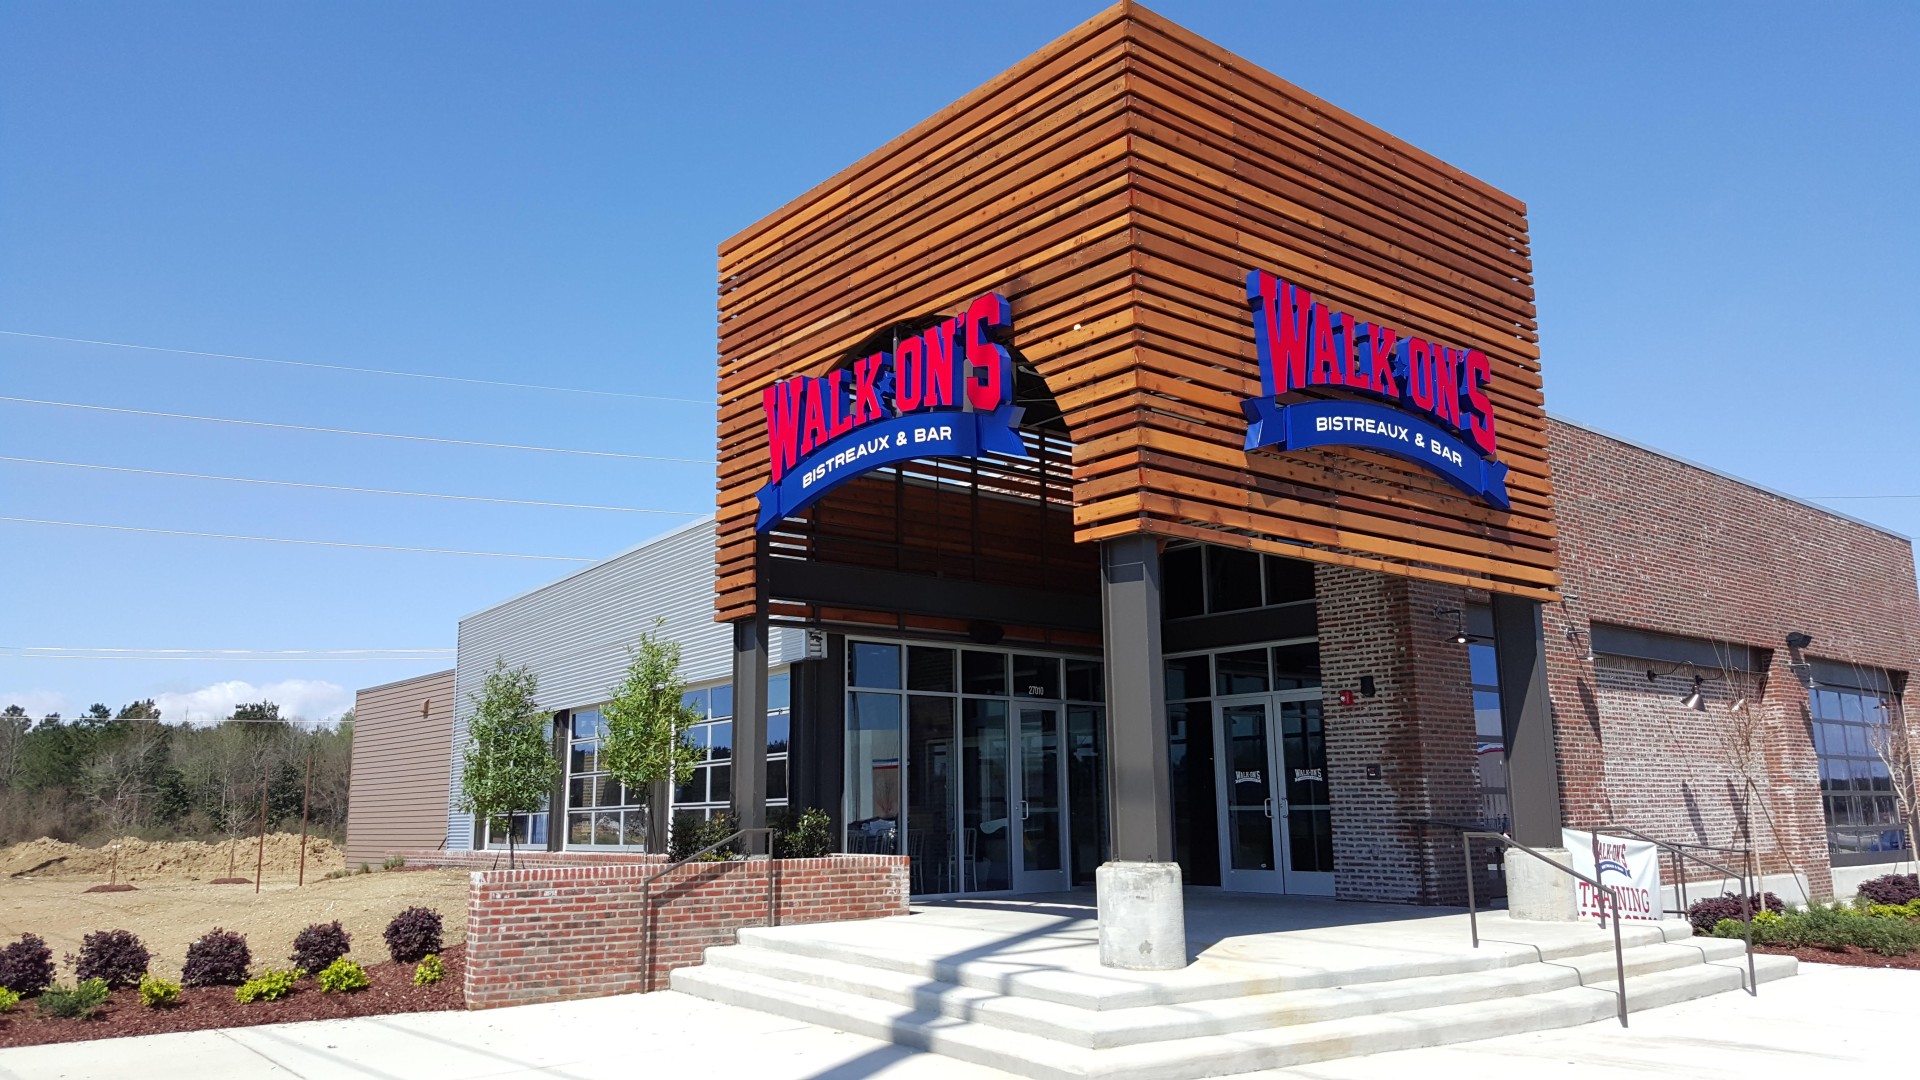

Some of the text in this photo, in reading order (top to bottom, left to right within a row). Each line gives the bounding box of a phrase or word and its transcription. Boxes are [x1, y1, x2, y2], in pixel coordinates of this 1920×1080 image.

[802, 426, 952, 489] BISTREAUX & BAR
[1315, 416, 1463, 467] BISTREAUX & BAR
[1028, 685, 1044, 696] 27010
[1578, 881, 1650, 914] TRANING
